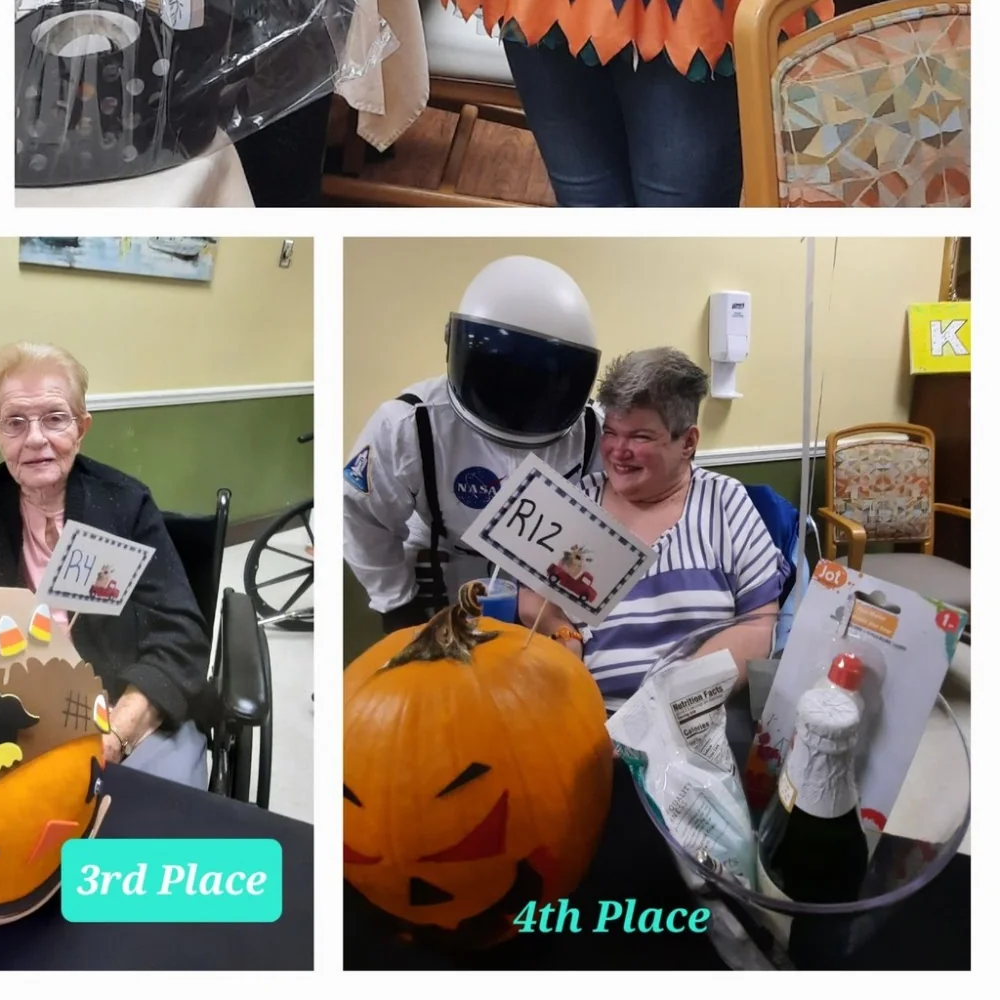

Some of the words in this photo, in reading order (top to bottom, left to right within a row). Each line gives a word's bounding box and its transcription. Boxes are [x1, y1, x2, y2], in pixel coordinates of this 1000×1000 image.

[456, 482, 498, 496] NASA
[506, 498, 563, 553] R12
[62, 547, 97, 587] R4
[672, 694, 703, 712] Nutrition
[703, 685, 724, 699] Facts
[683, 721, 710, 737] Calories
